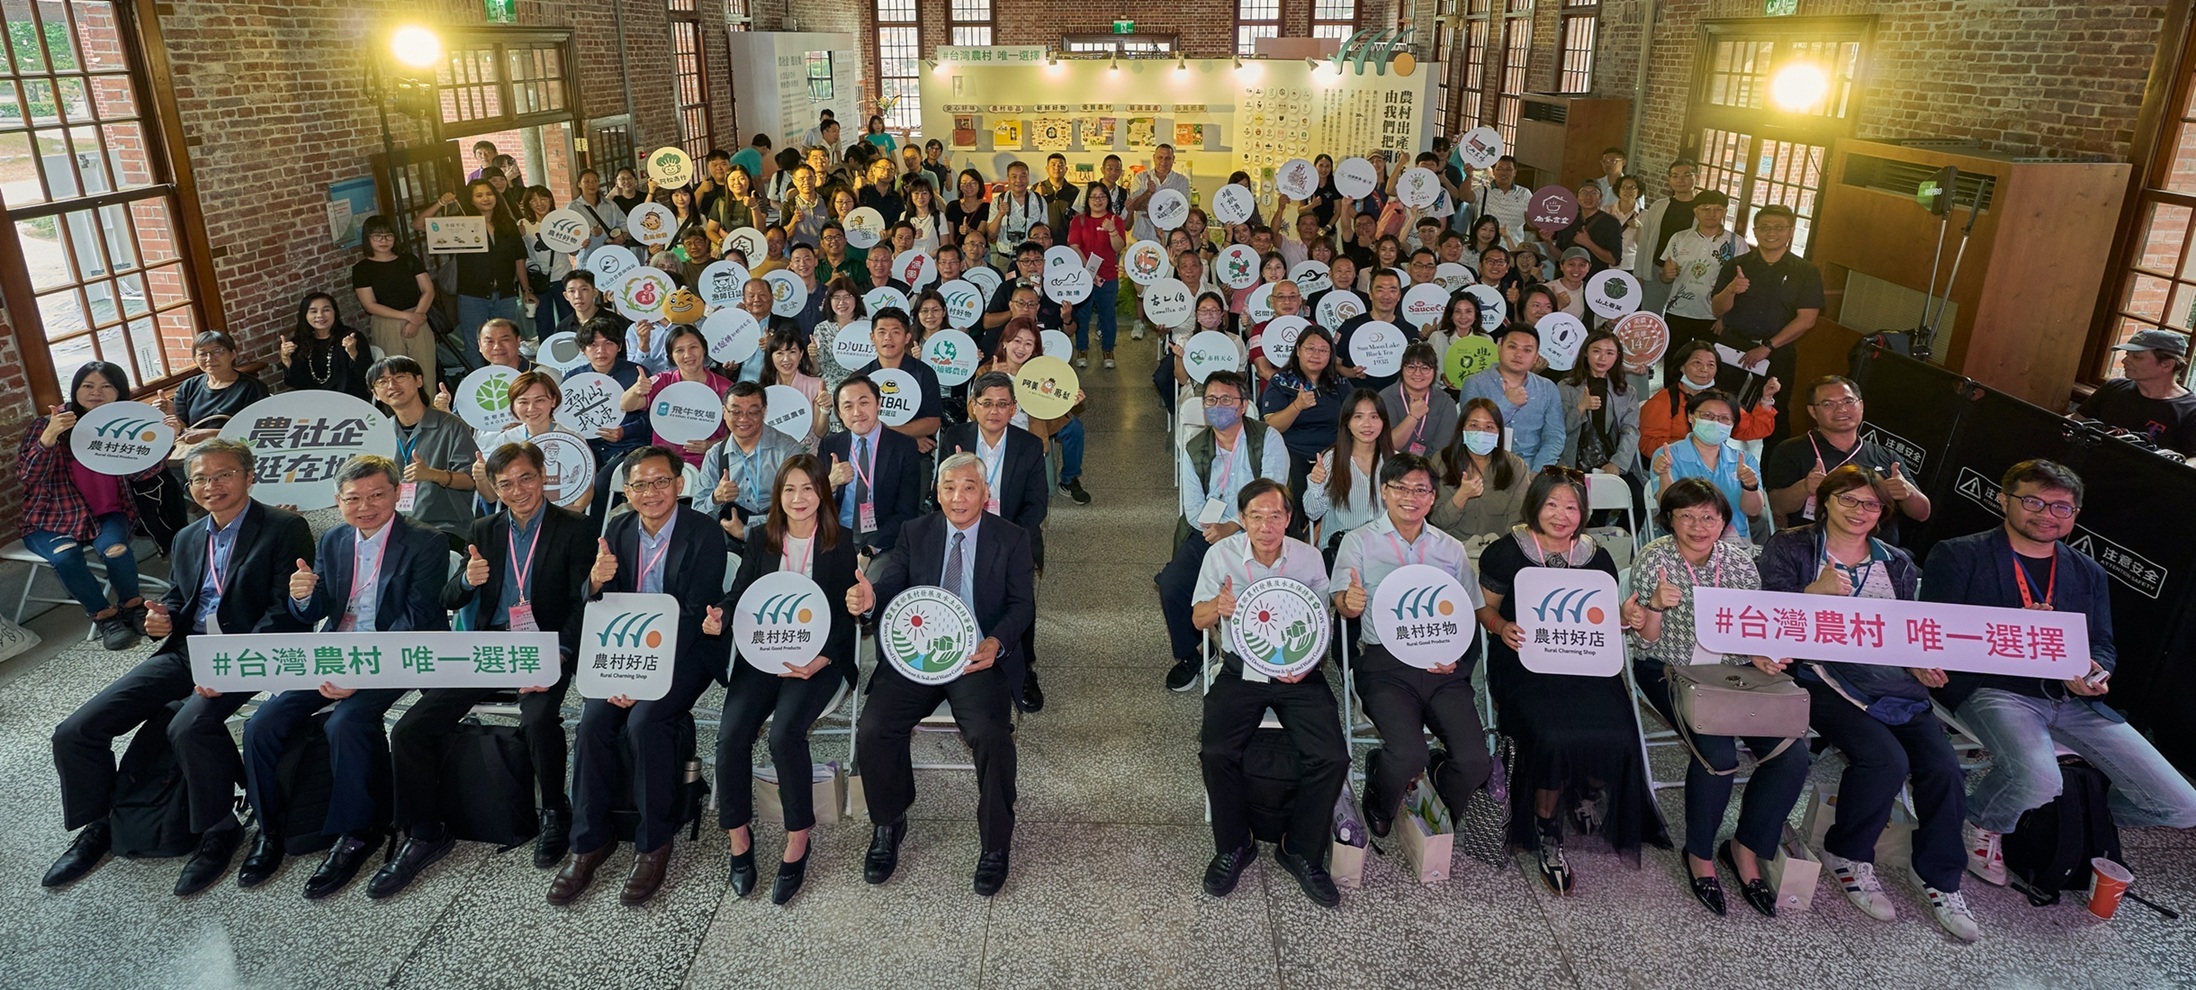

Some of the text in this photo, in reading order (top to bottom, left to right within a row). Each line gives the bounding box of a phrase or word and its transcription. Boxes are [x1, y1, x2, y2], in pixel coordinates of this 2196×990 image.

[942, 50, 1041, 62] #台灣農村 唯一選擇
[547, 230, 578, 245] 農村好物
[948, 308, 972, 319] 村好物
[1630, 337, 1650, 350] 147
[671, 405, 716, 420] 飛牛牧場
[880, 396, 911, 412] IBAL
[248, 416, 369, 448] 農社企
[87, 440, 151, 456] 農村好物
[1885, 437, 1922, 463] 注意安全
[2102, 546, 2160, 584] 注意安全
[2100, 560, 2155, 590] ATTENTION SAFETY
[750, 628, 811, 645] 農村好物
[1396, 620, 1458, 640] 農村好物
[1534, 627, 1605, 648] 農村好店
[1715, 605, 2068, 662] #台灣農村 唯一選擇
[1558, 648, 1582, 656] Charming
[213, 645, 542, 678] #台灣農村 唯一選擇
[592, 653, 659, 671] 農村好店
